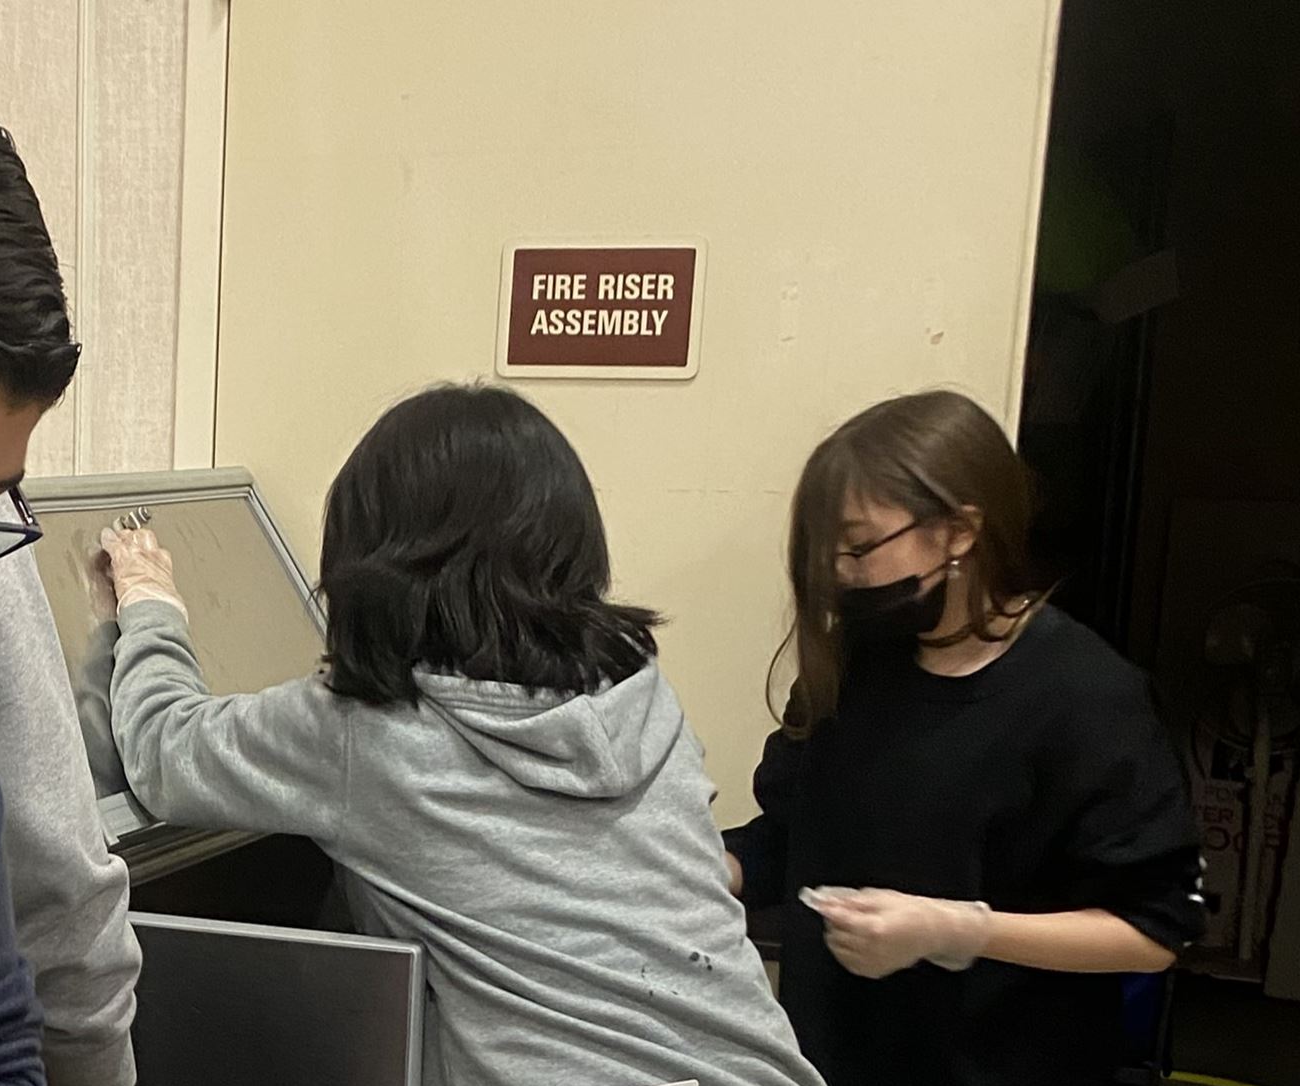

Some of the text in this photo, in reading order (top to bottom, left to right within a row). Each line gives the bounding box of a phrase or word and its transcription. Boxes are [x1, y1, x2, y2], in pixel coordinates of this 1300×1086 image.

[532, 273, 674, 300] FIRE RISER
[531, 309, 668, 336] ASSEMBLY
